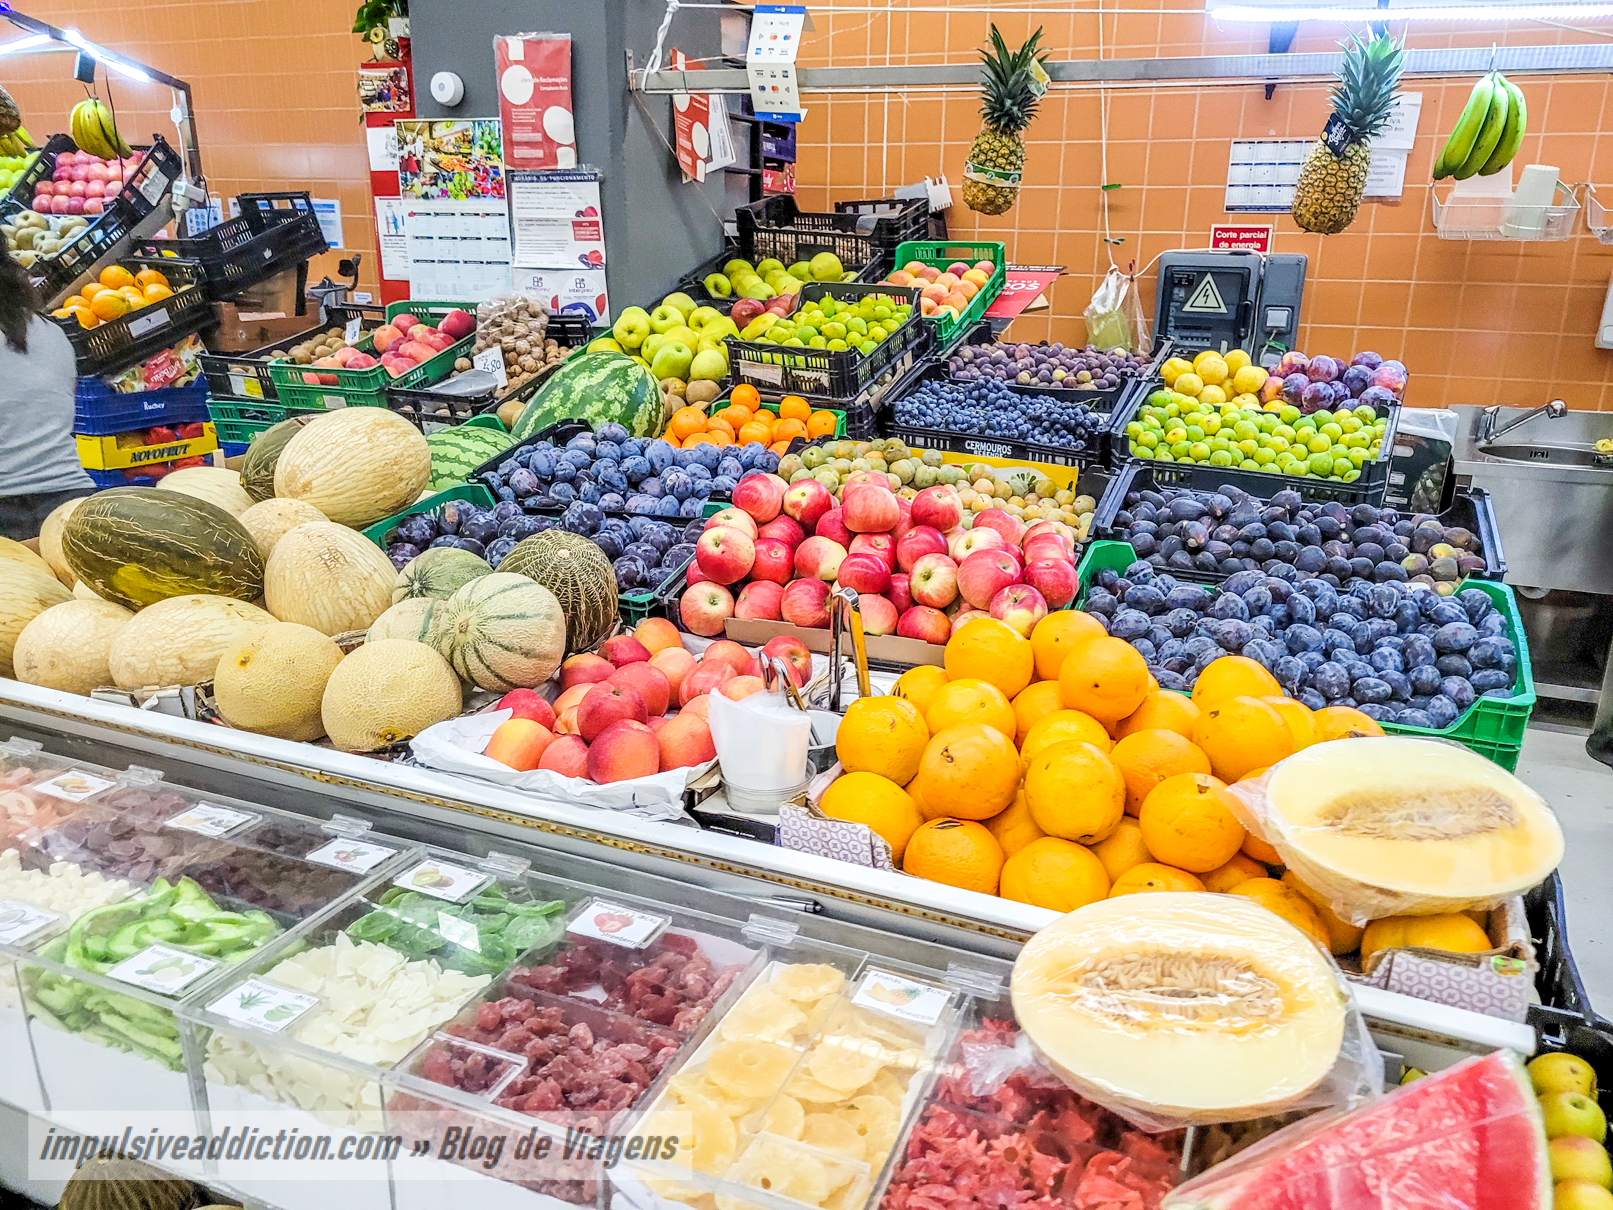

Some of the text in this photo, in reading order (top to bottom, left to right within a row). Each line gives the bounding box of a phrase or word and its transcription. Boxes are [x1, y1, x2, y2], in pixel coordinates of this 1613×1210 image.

[1215, 230, 1267, 240] Corte parcial
[1218, 241, 1261, 249] de energia
[964, 439, 1013, 455] CERMOUROS
[895, 1006, 935, 1020] Pineapple
